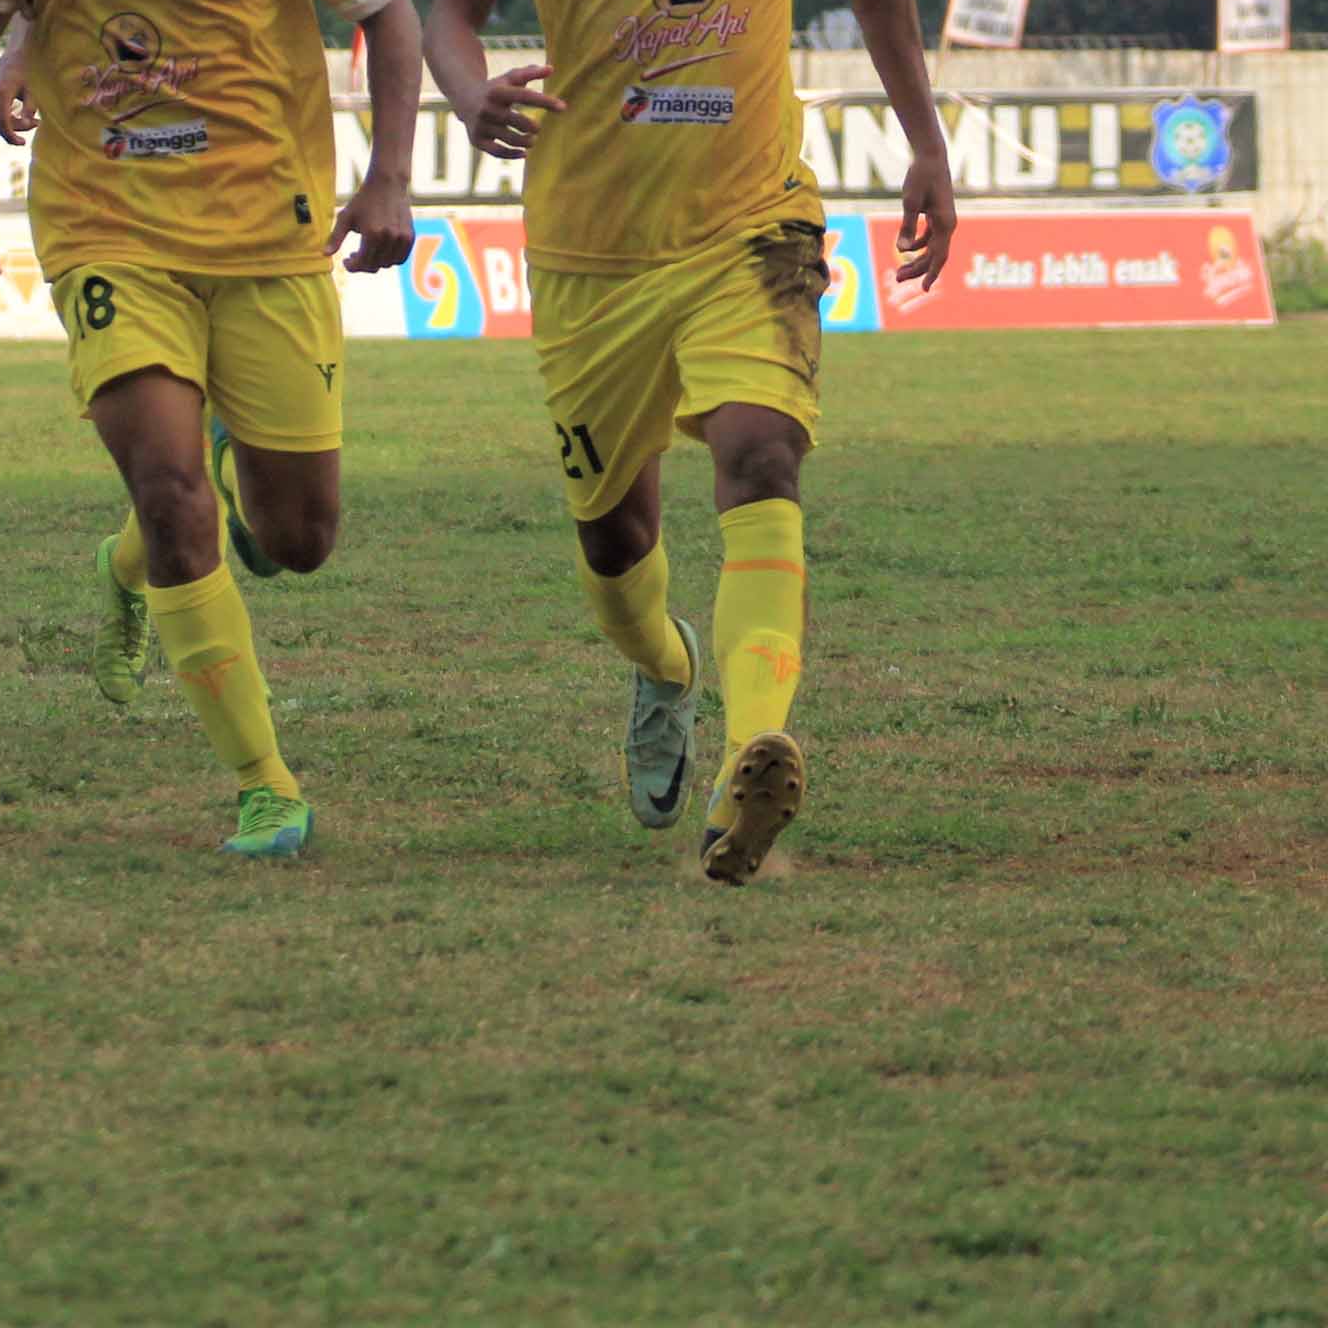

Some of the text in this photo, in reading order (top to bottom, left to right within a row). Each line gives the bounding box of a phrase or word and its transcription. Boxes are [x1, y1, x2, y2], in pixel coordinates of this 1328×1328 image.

[614, 2, 751, 65] Kapal Api
[652, 98, 734, 117] mangga
[1042, 250, 1109, 288] lebih
[1115, 250, 1181, 286] enak
[555, 421, 605, 479] 21
